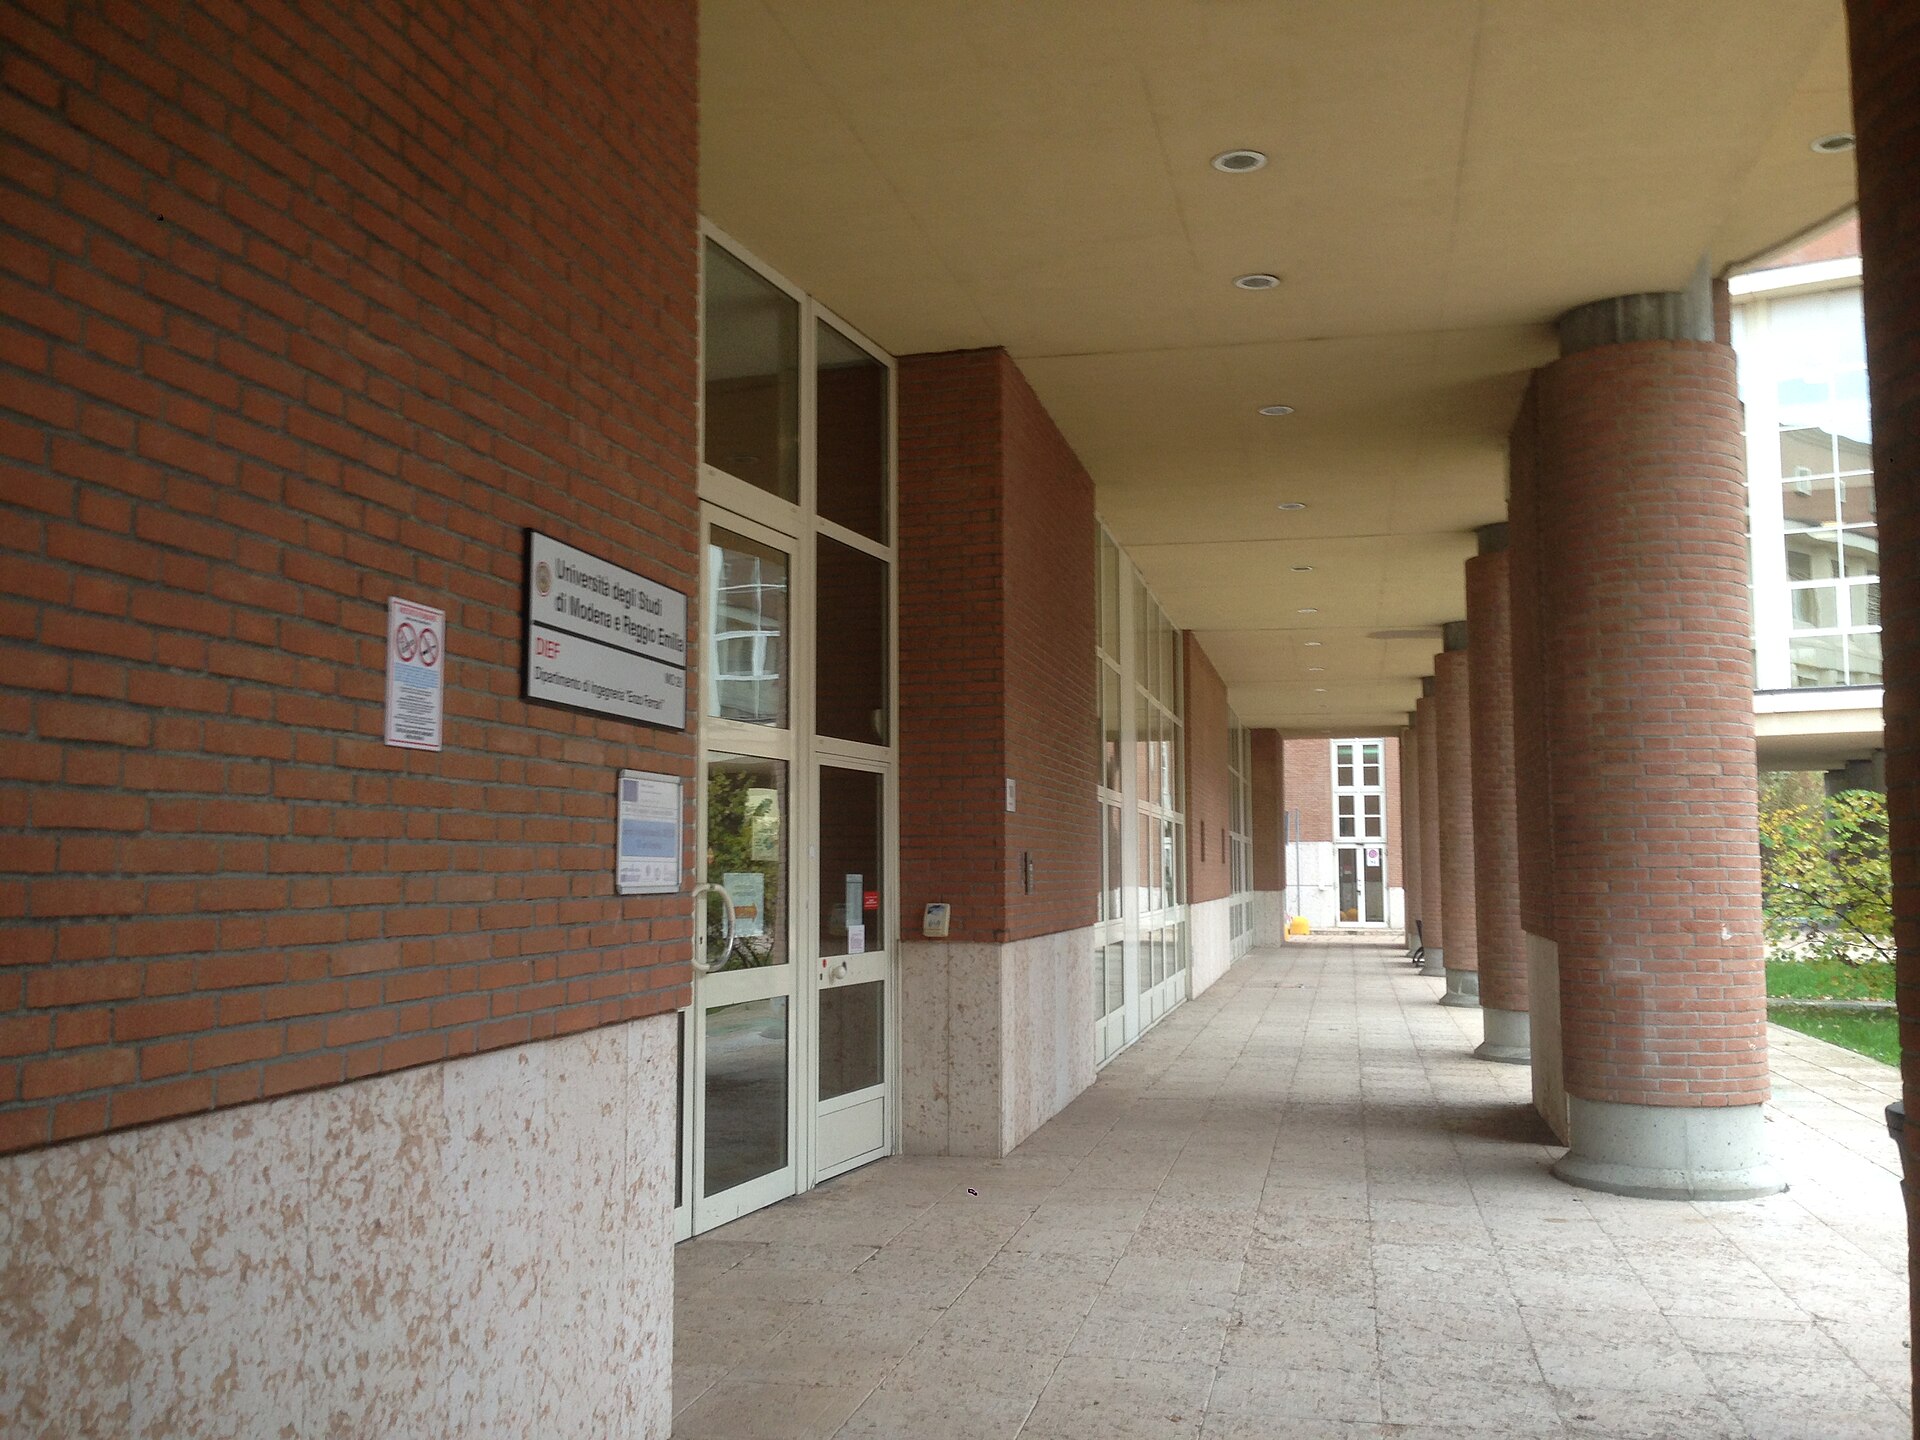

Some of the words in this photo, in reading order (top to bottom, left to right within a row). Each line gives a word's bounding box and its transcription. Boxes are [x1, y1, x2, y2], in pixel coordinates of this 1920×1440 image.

[613, 582, 636, 609] degli
[639, 591, 663, 616] Studi
[555, 592, 567, 613] di
[569, 595, 612, 628] Modena
[614, 616, 621, 631] e
[623, 615, 656, 645] Reggio
[658, 627, 684, 652] Emilia
[536, 636, 560, 660] DIEF
[534, 666, 581, 690] Dipartimento
[582, 680, 590, 692] di
